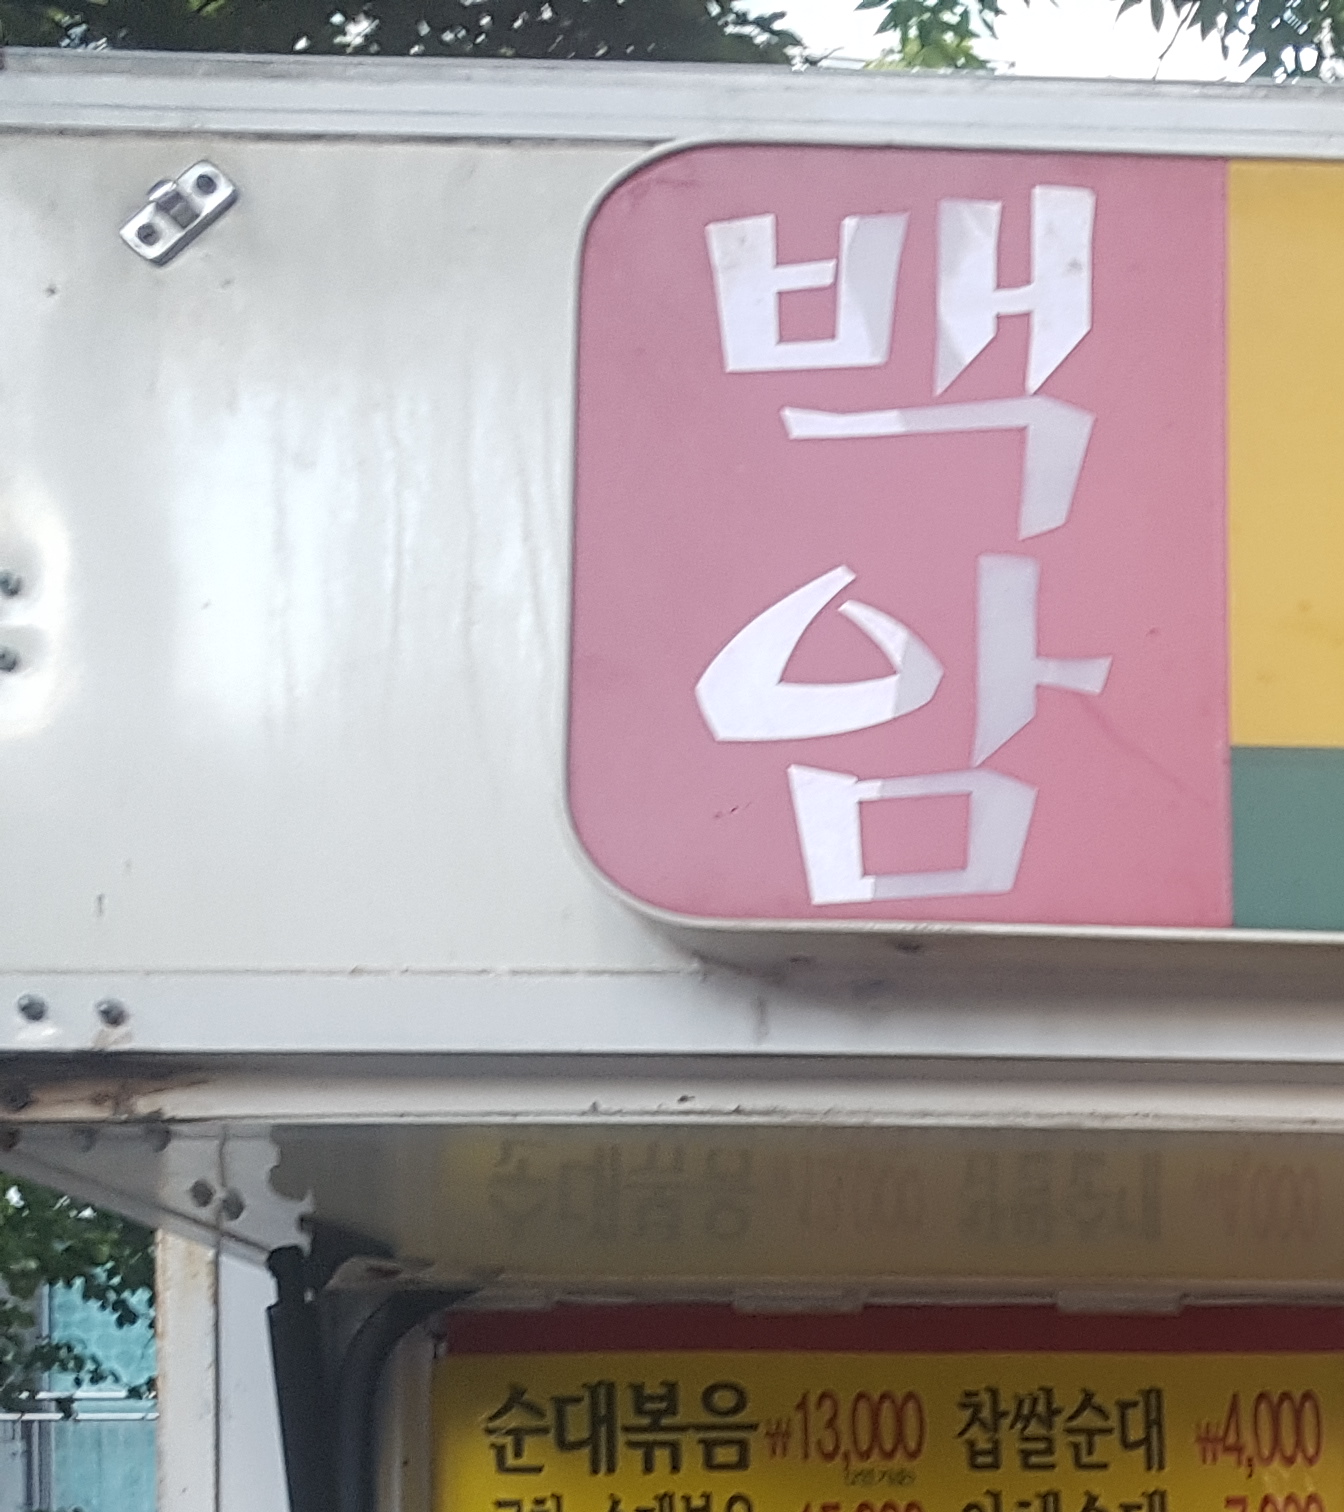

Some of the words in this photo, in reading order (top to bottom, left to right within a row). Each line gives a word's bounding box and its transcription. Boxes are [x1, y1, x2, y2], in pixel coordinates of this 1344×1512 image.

[694, 184, 1112, 906] 백암
[484, 1379, 760, 1476] 순대볶음
[956, 1385, 1166, 1473] 찹쌀순대
